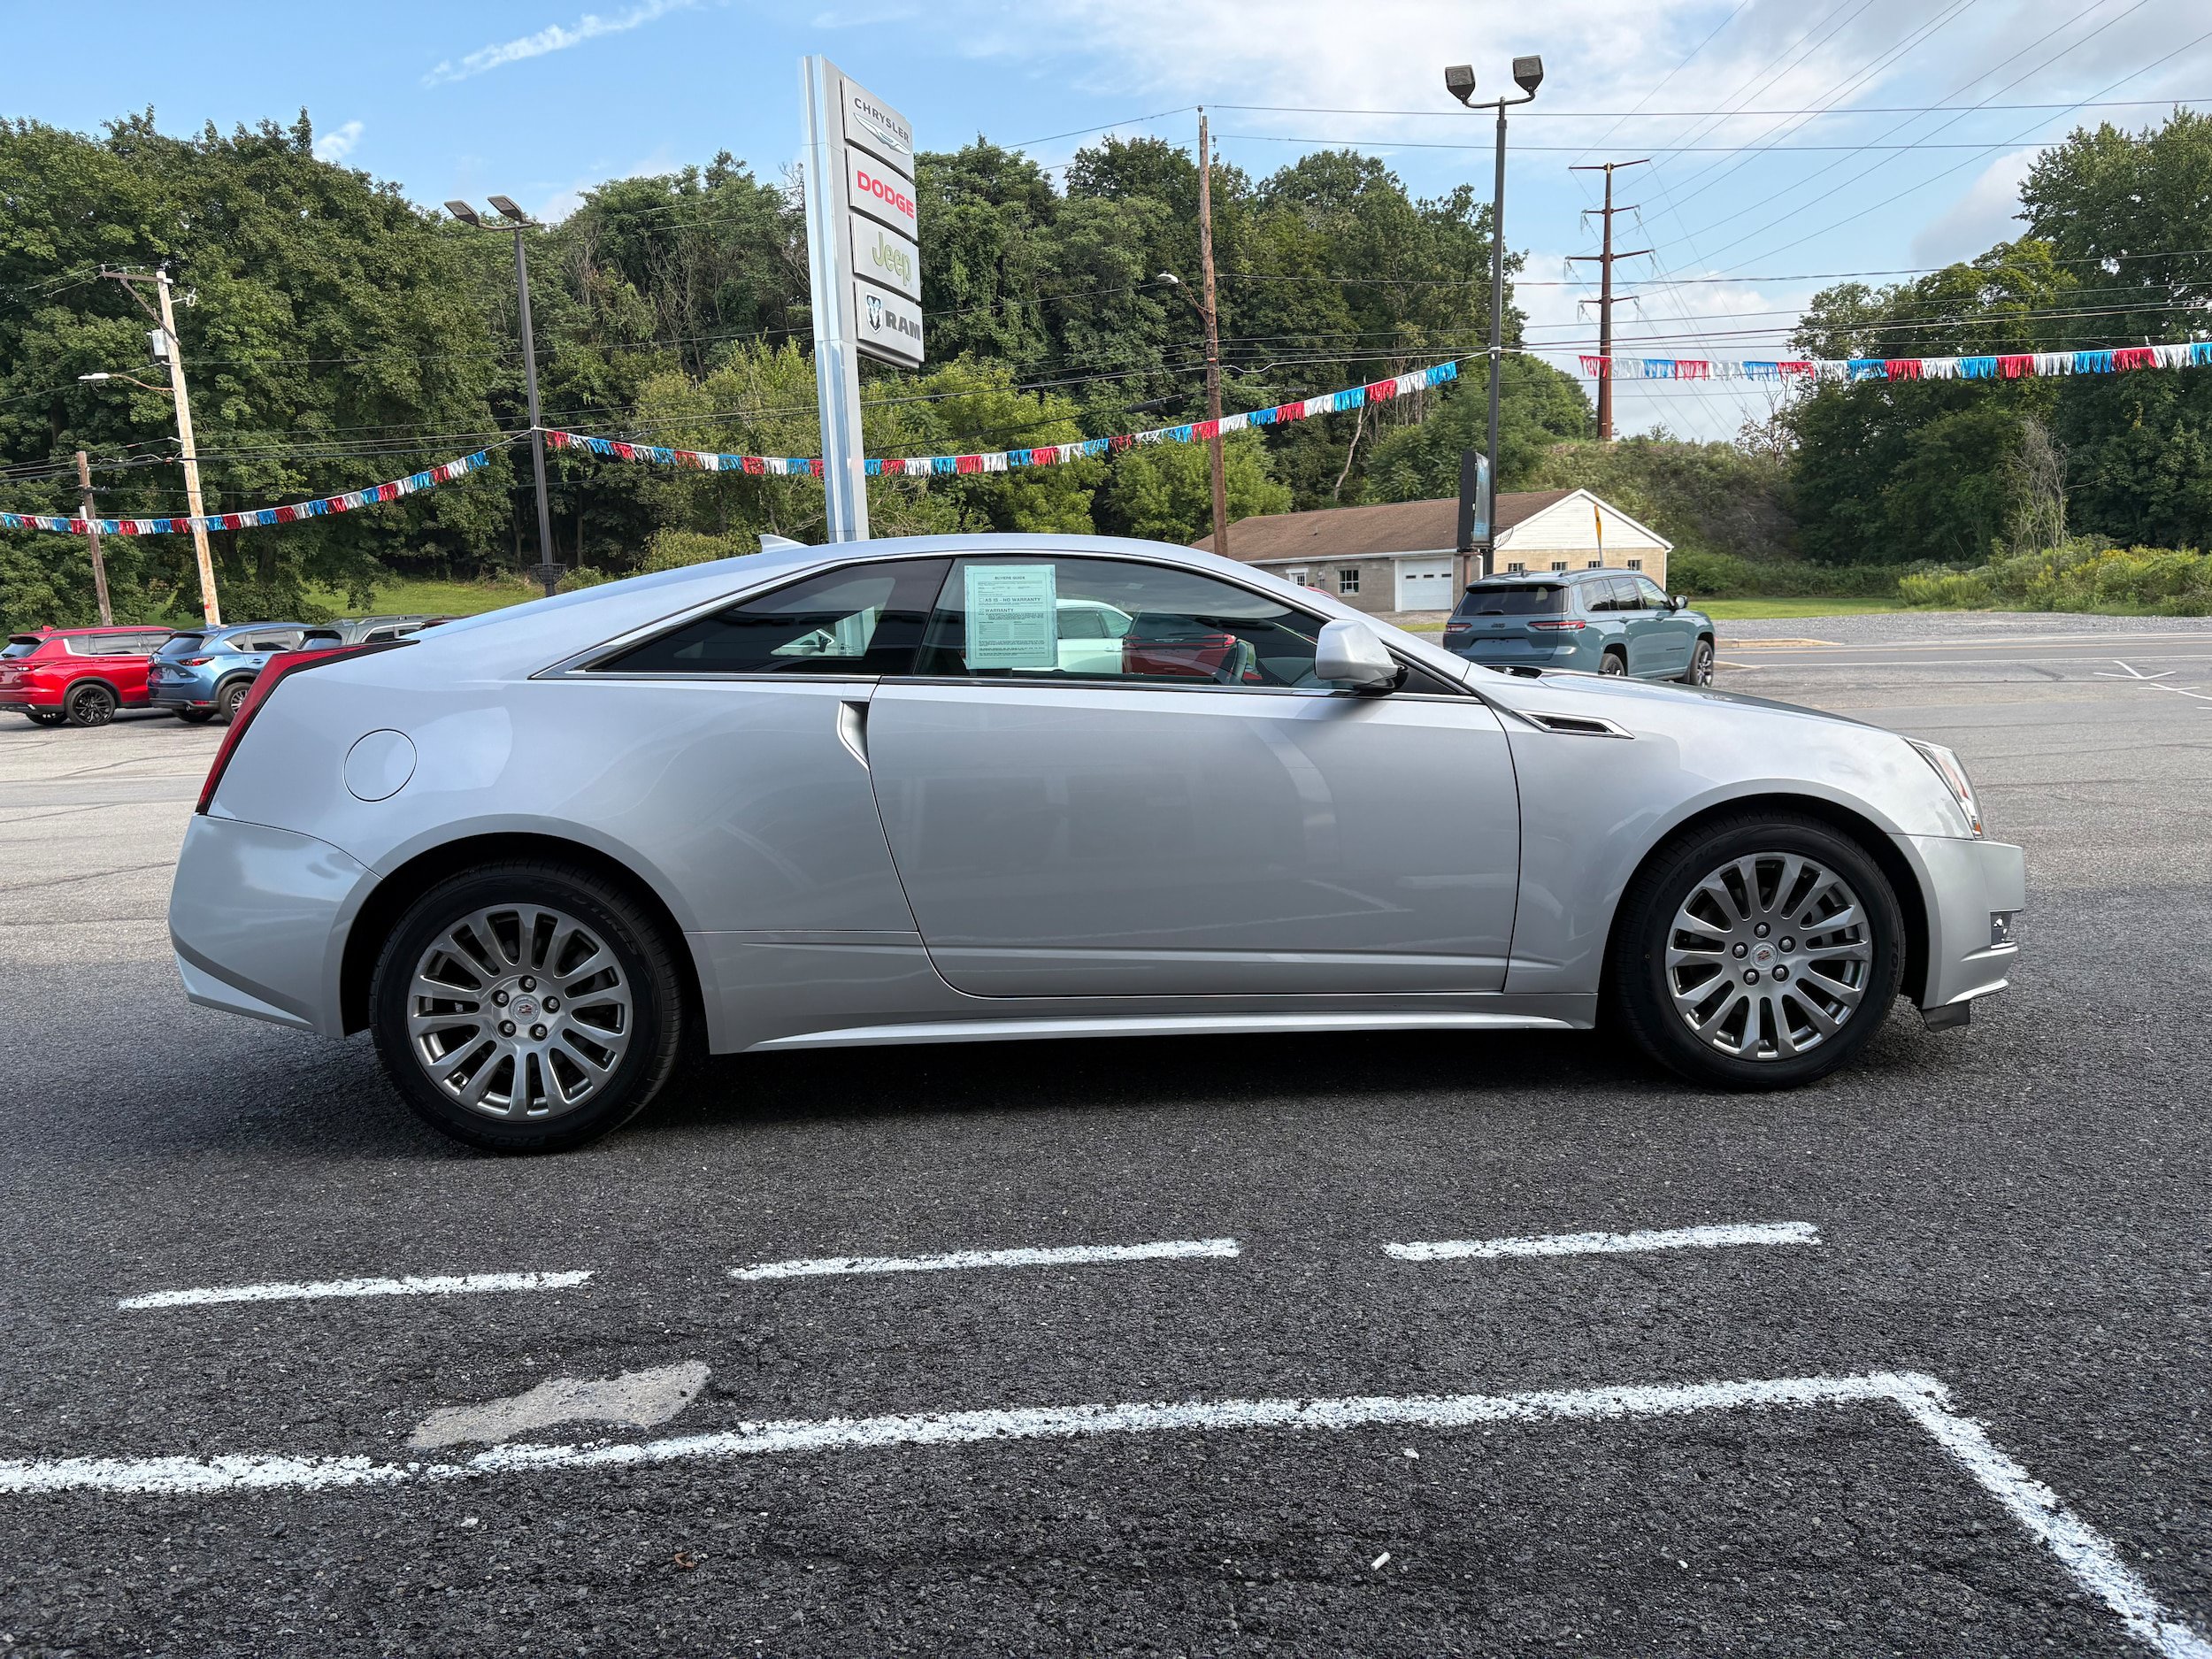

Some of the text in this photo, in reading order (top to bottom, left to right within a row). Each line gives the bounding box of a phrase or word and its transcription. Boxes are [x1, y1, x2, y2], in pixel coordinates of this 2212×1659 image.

[854, 97, 910, 143] CHRYSLER
[856, 170, 915, 219] DODGE
[872, 231, 911, 287] Jeep
[885, 310, 921, 342] RAM
